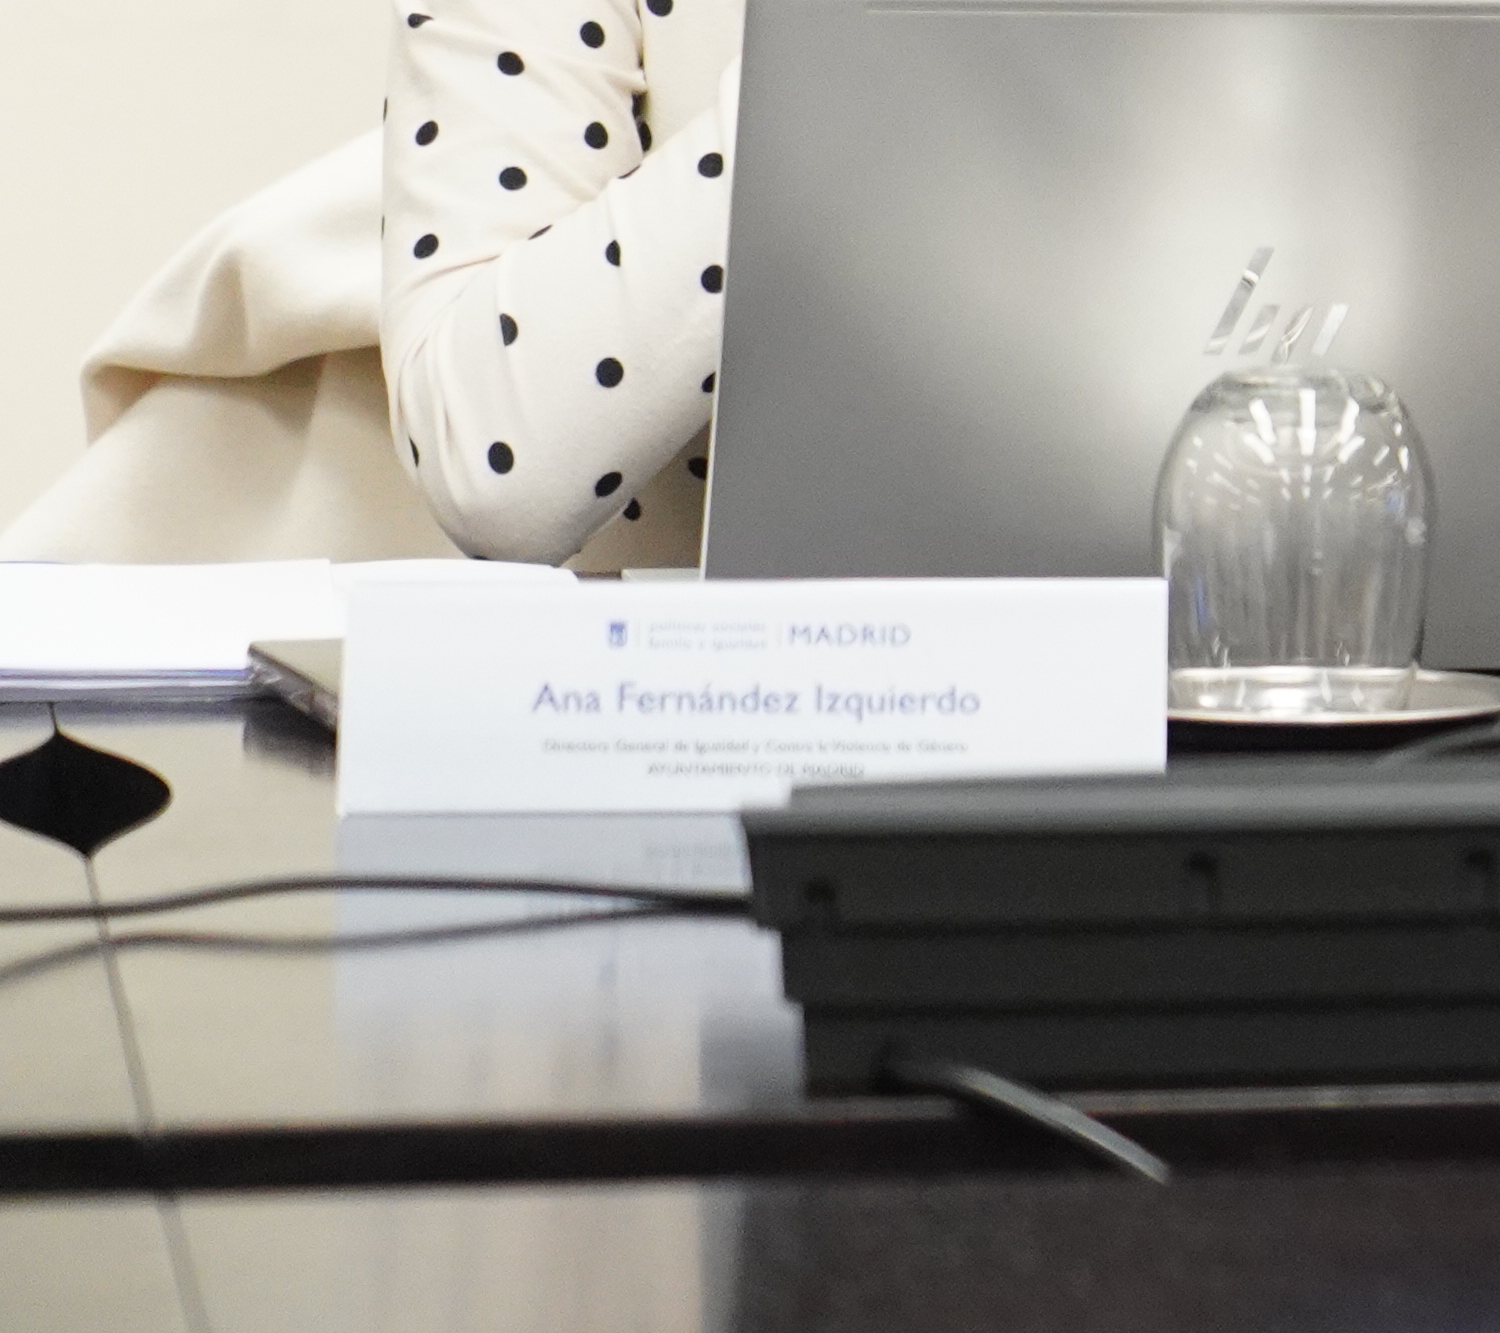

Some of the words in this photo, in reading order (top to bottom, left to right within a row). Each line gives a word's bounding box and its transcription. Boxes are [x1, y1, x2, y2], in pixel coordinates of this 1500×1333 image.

[788, 622, 913, 648] MADRID
[531, 681, 602, 714] Ana
[616, 679, 800, 715] Fernández
[813, 682, 982, 723] Izquierdo
